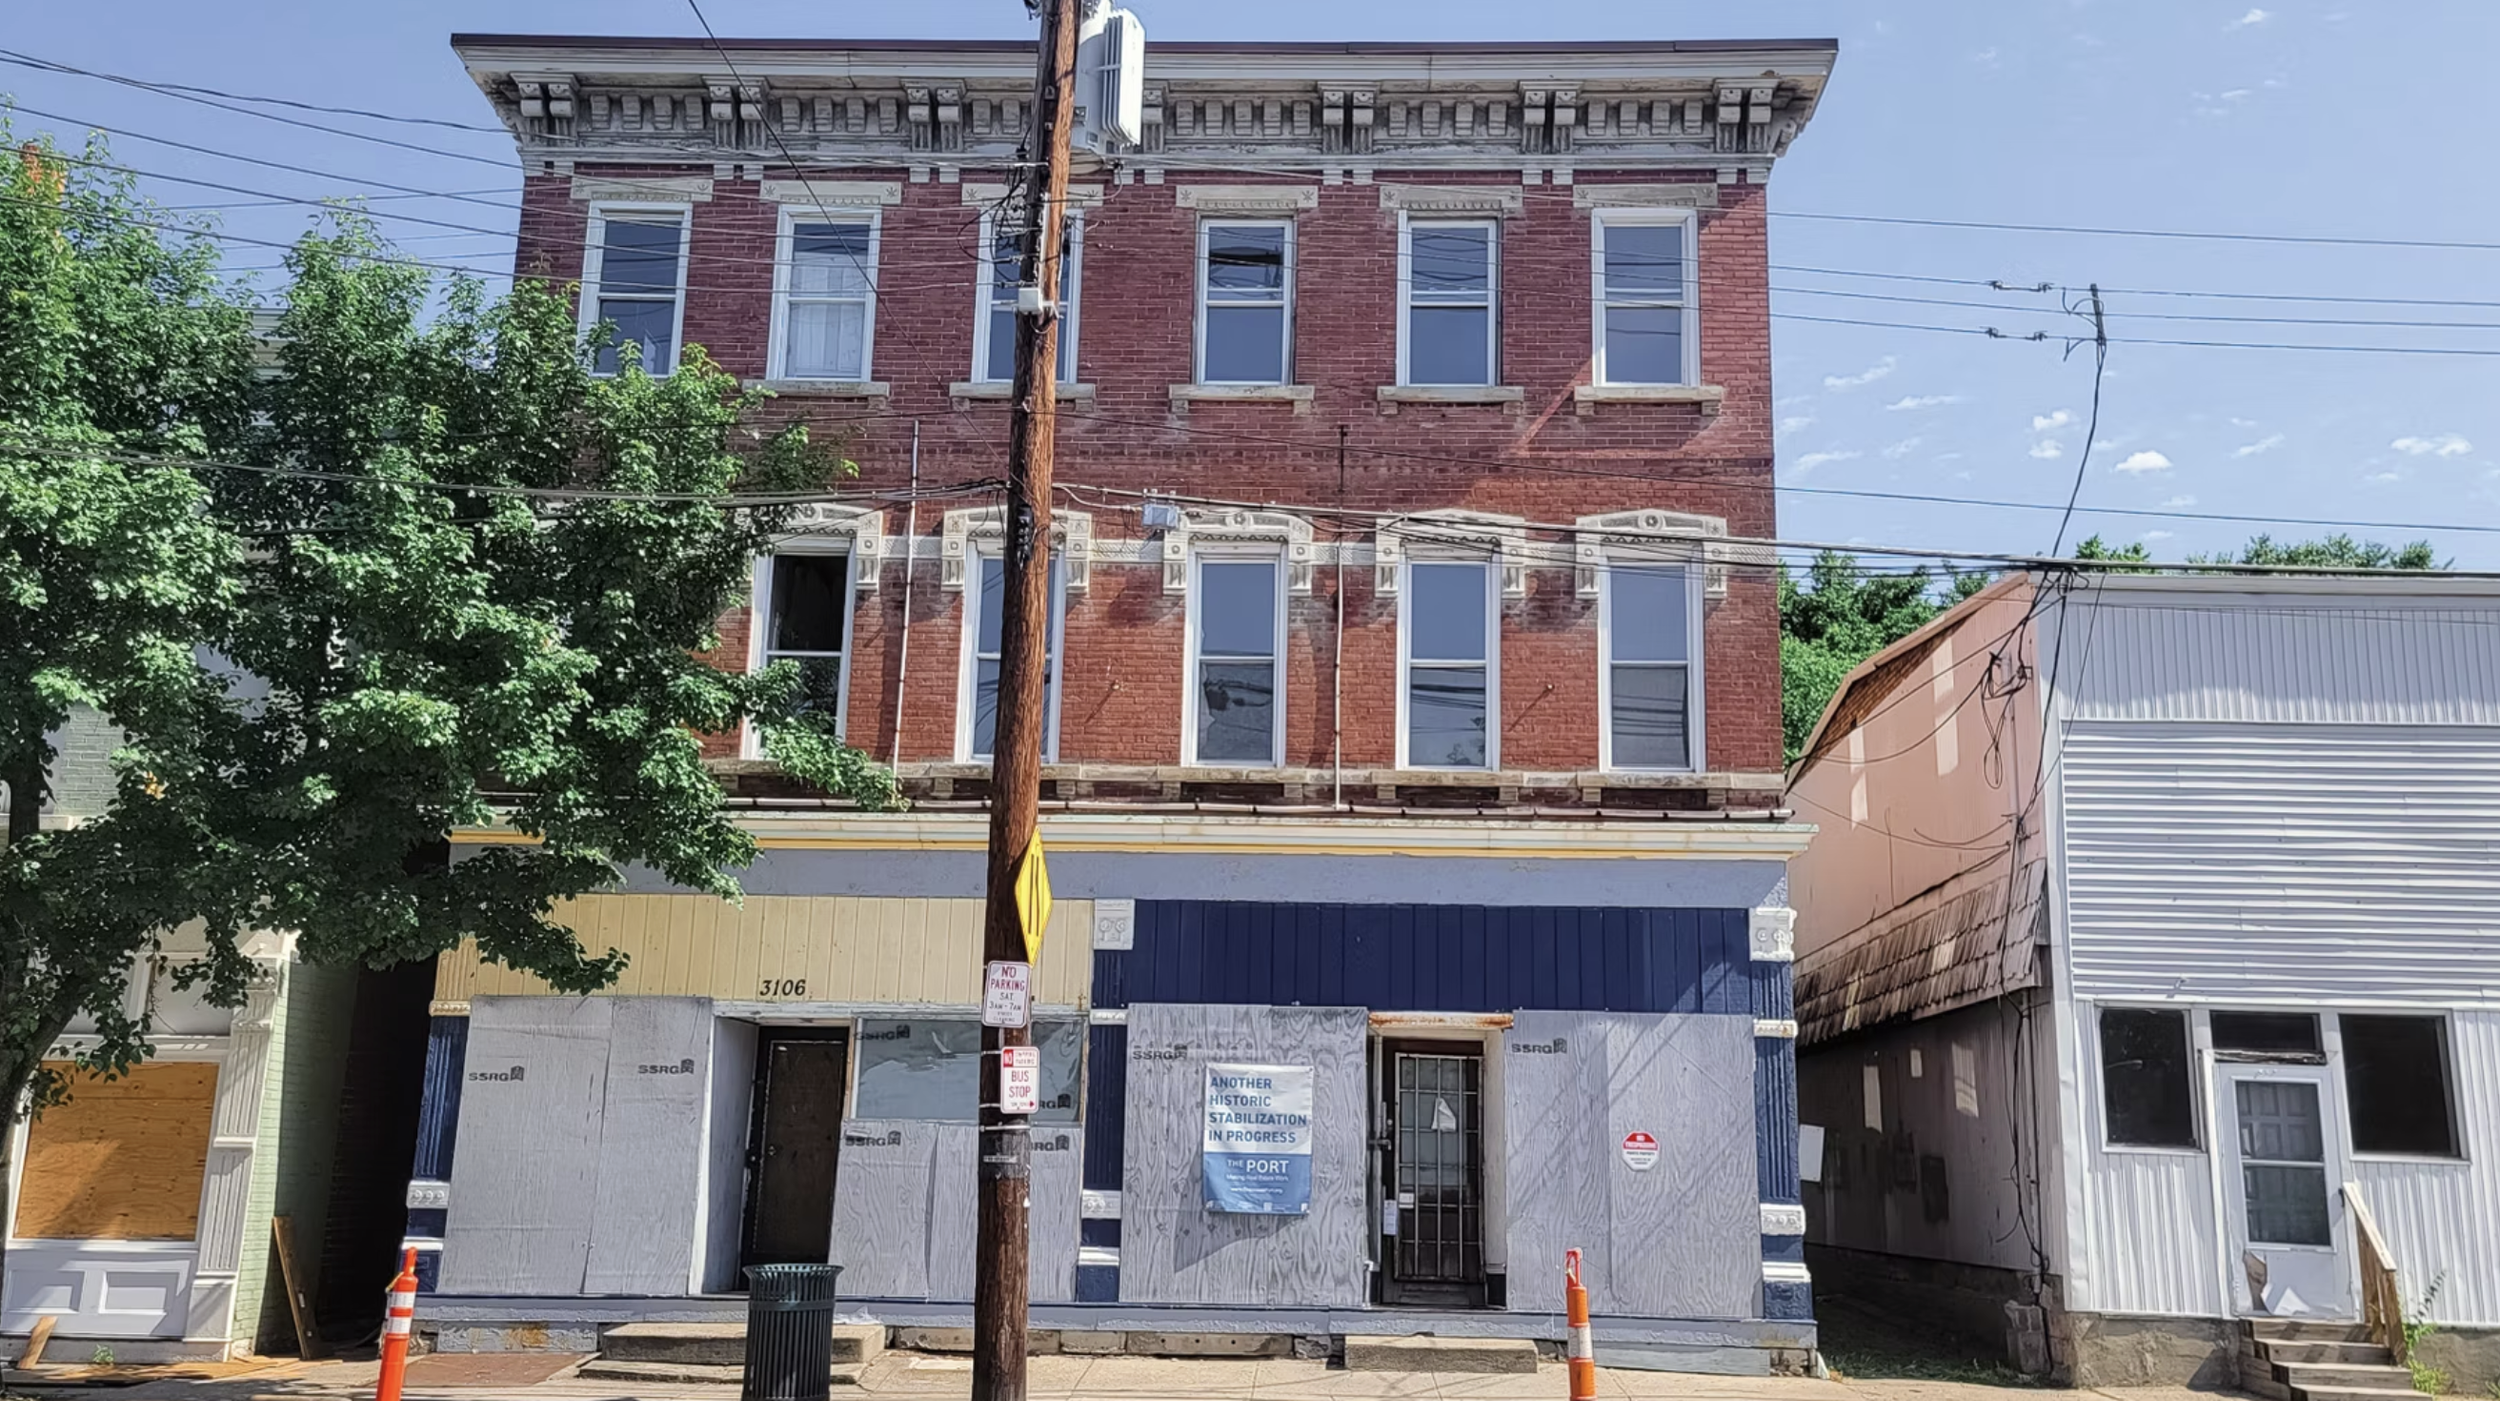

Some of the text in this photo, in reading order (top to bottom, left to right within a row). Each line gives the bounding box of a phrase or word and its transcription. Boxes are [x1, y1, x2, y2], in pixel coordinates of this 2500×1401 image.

[1001, 966, 1017, 978] NO
[760, 979, 806, 996] 3106
[990, 979, 1025, 992] PARKING
[638, 1064, 679, 1074] SSRG
[468, 1072, 509, 1081] SSRG
[1011, 1070, 1029, 1082] BUS
[1210, 1077, 1272, 1089] ANOTHER
[1009, 1085, 1031, 1098] STOP
[1209, 1095, 1272, 1107] HISTORIC
[1209, 1112, 1307, 1126] STABILIZATION
[1209, 1130, 1297, 1144] IN PROGRESS
[1227, 1159, 1289, 1173] THE PORT
